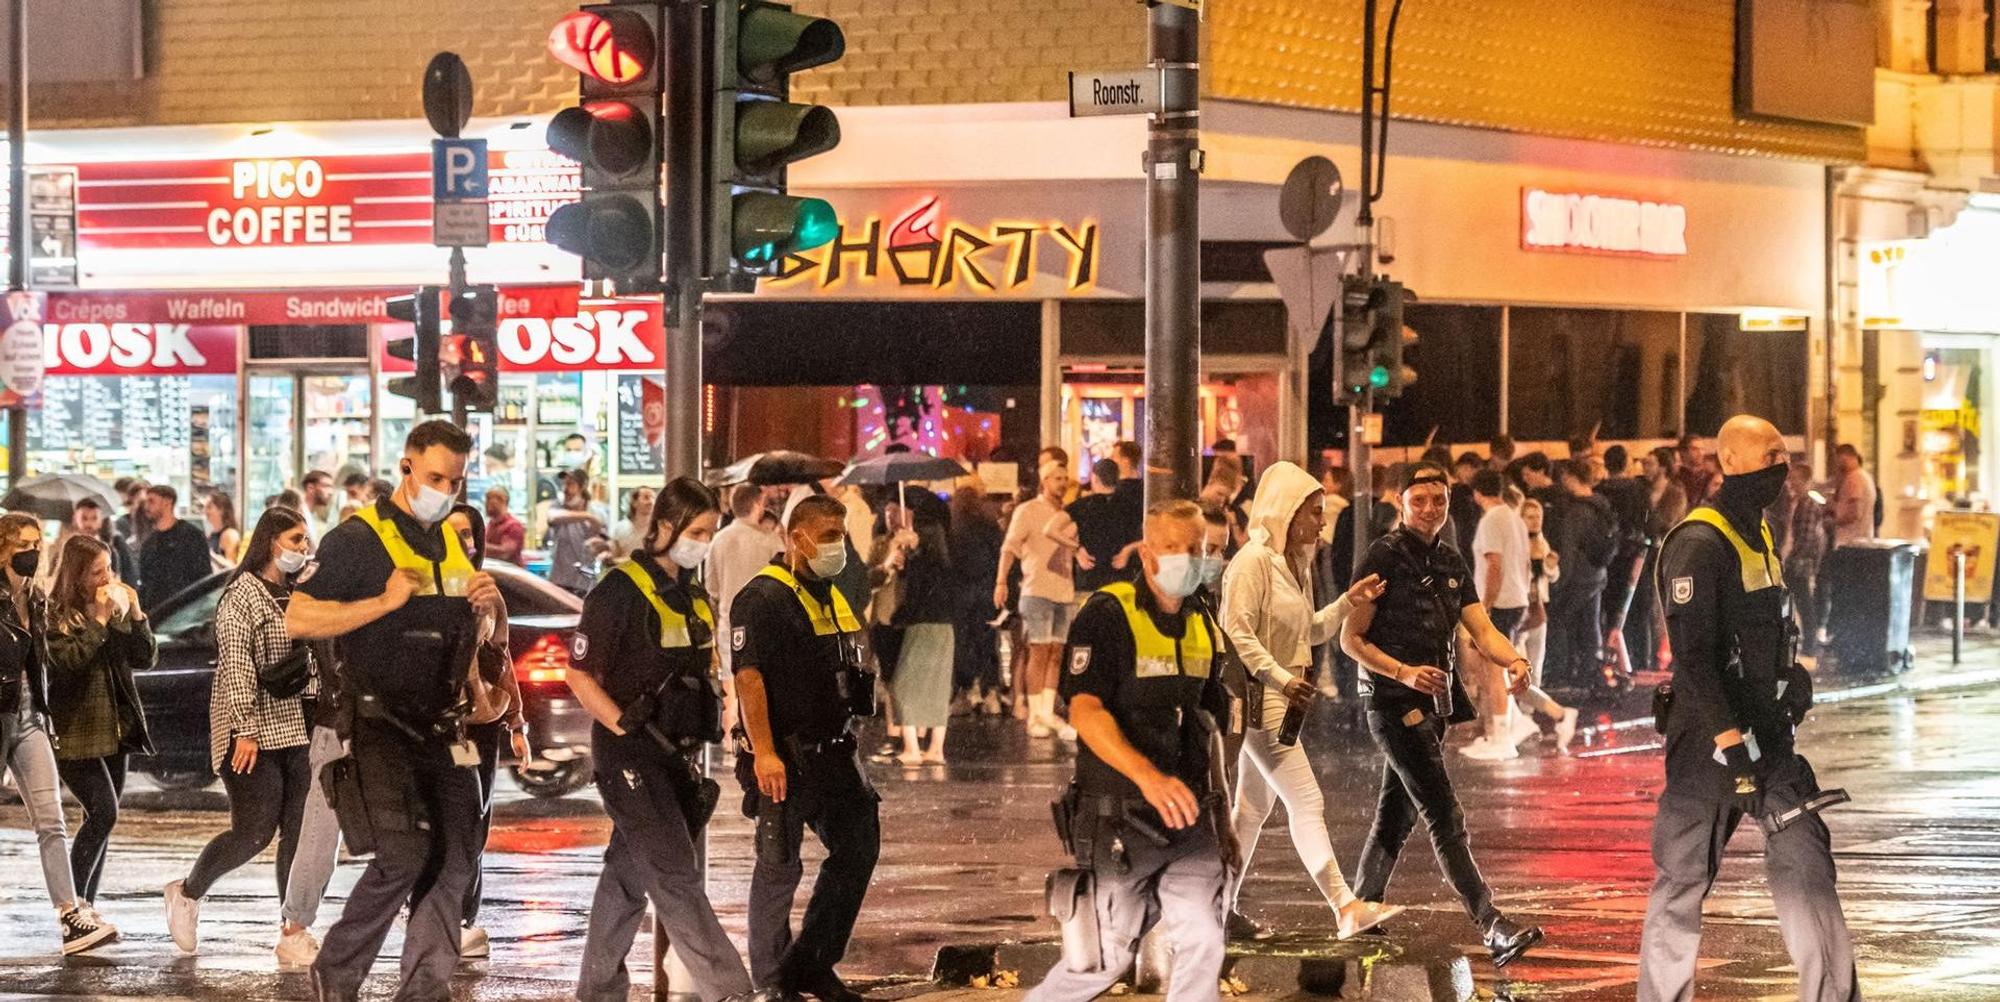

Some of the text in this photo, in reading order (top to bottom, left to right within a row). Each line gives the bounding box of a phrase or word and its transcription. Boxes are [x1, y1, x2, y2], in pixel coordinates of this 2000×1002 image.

[1093, 78, 1144, 105] Roonstr.
[233, 159, 323, 199] PICO
[446, 147, 476, 191] P
[207, 205, 353, 245] COFFEE
[55, 299, 128, 324] Crêpes
[166, 296, 245, 319] Waffeln
[43, 323, 207, 368] IOSK
